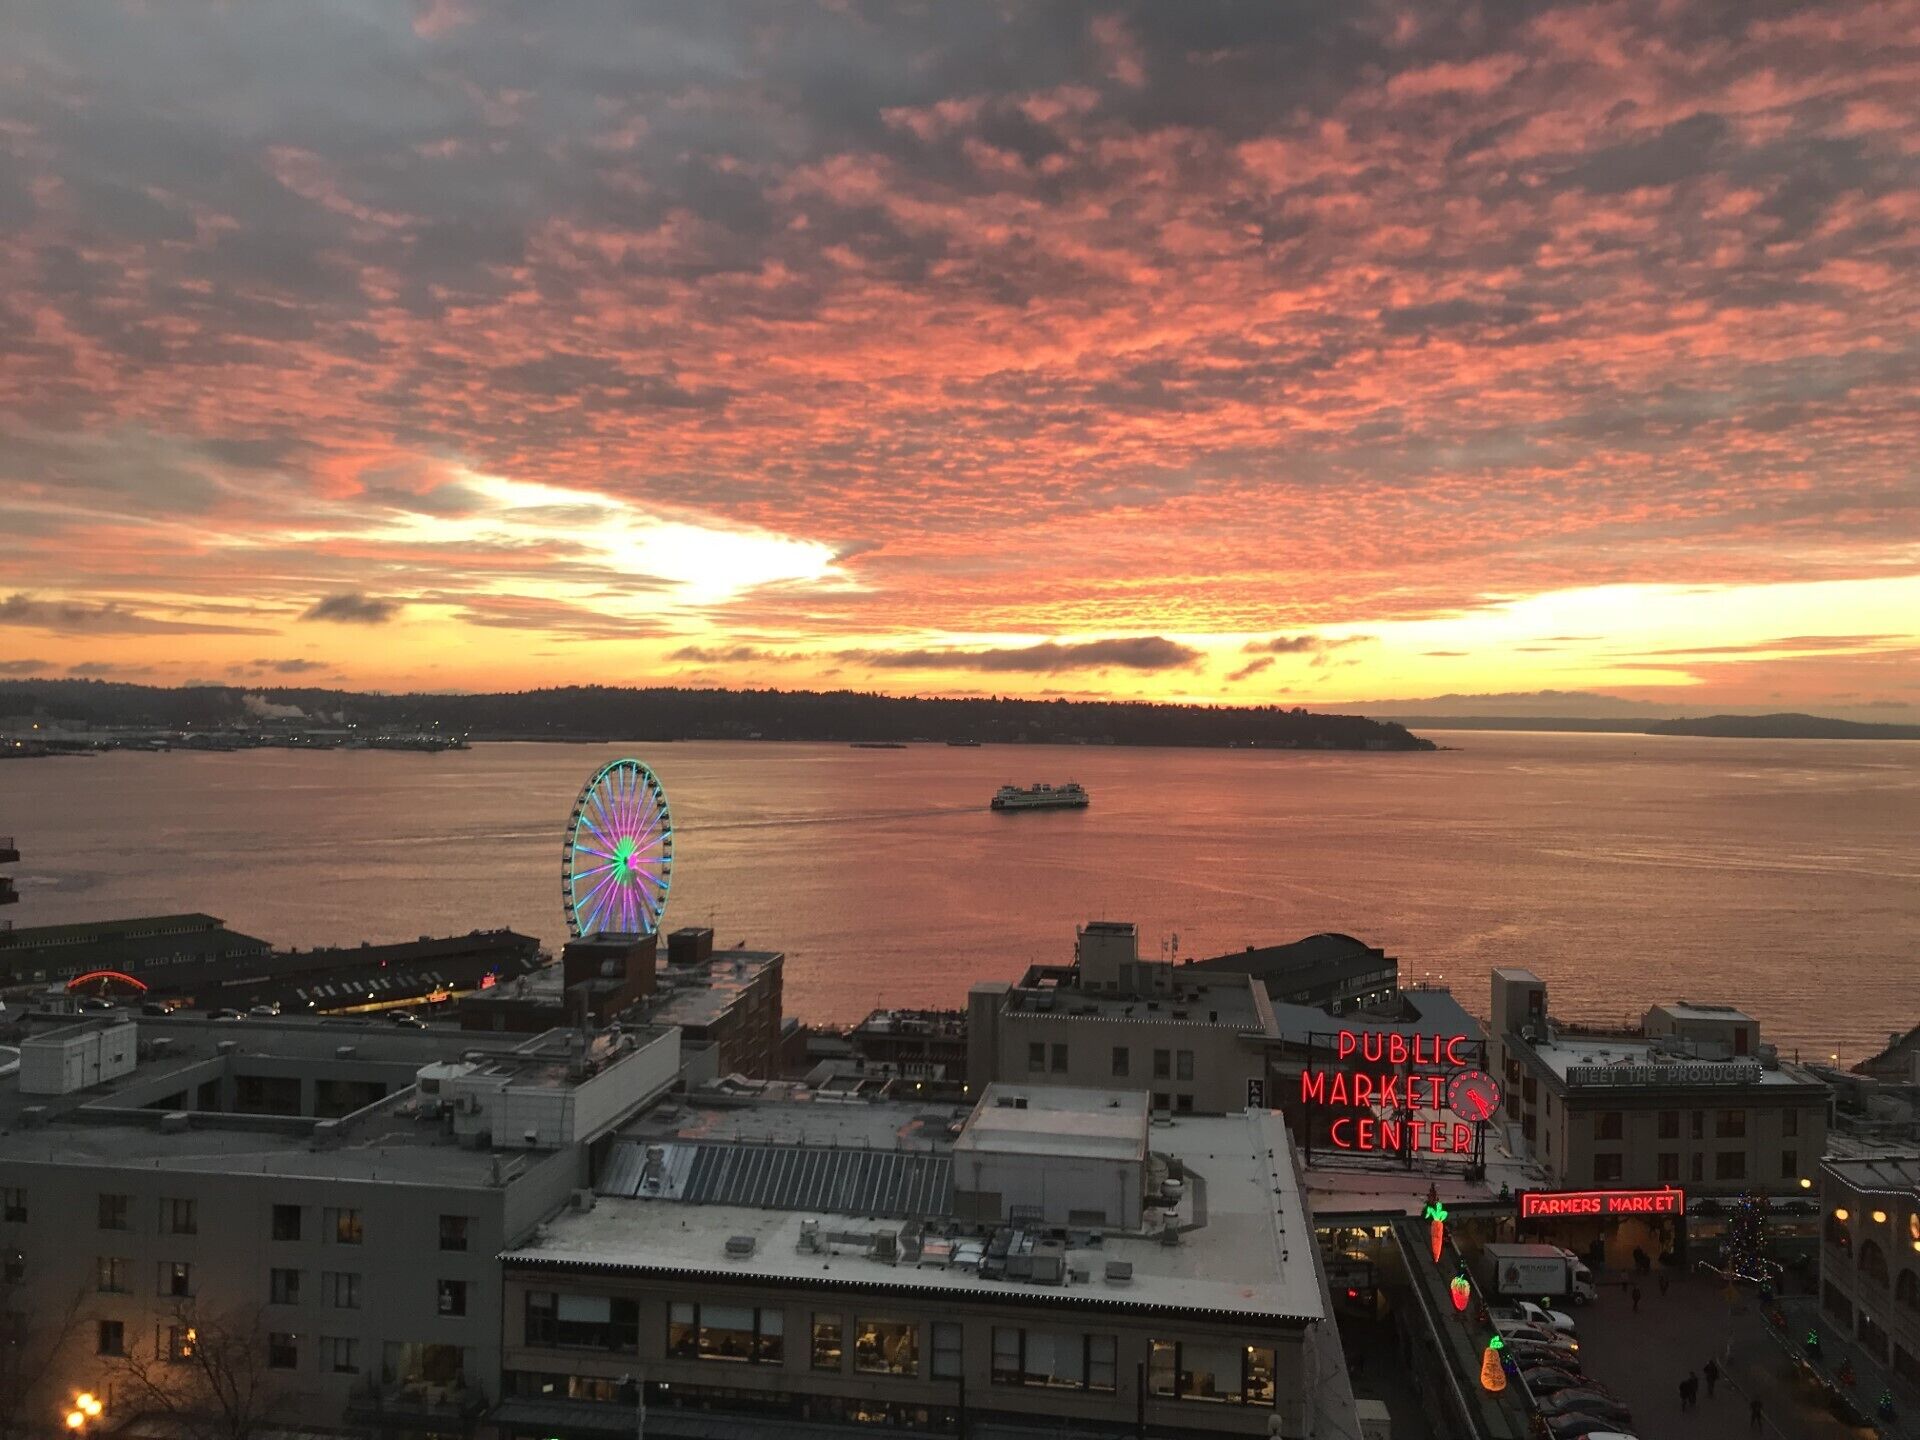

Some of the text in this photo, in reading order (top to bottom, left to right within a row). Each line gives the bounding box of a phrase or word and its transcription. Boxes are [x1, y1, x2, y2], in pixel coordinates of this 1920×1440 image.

[1339, 1030, 1467, 1066] PUBLIC
[1301, 1070, 1446, 1110] MARKET
[1575, 1068, 1757, 1084] MEET THE PRODUCER
[1331, 1118, 1472, 1153] CENTER
[1530, 1196, 1675, 1215] FARMERS MARKET
